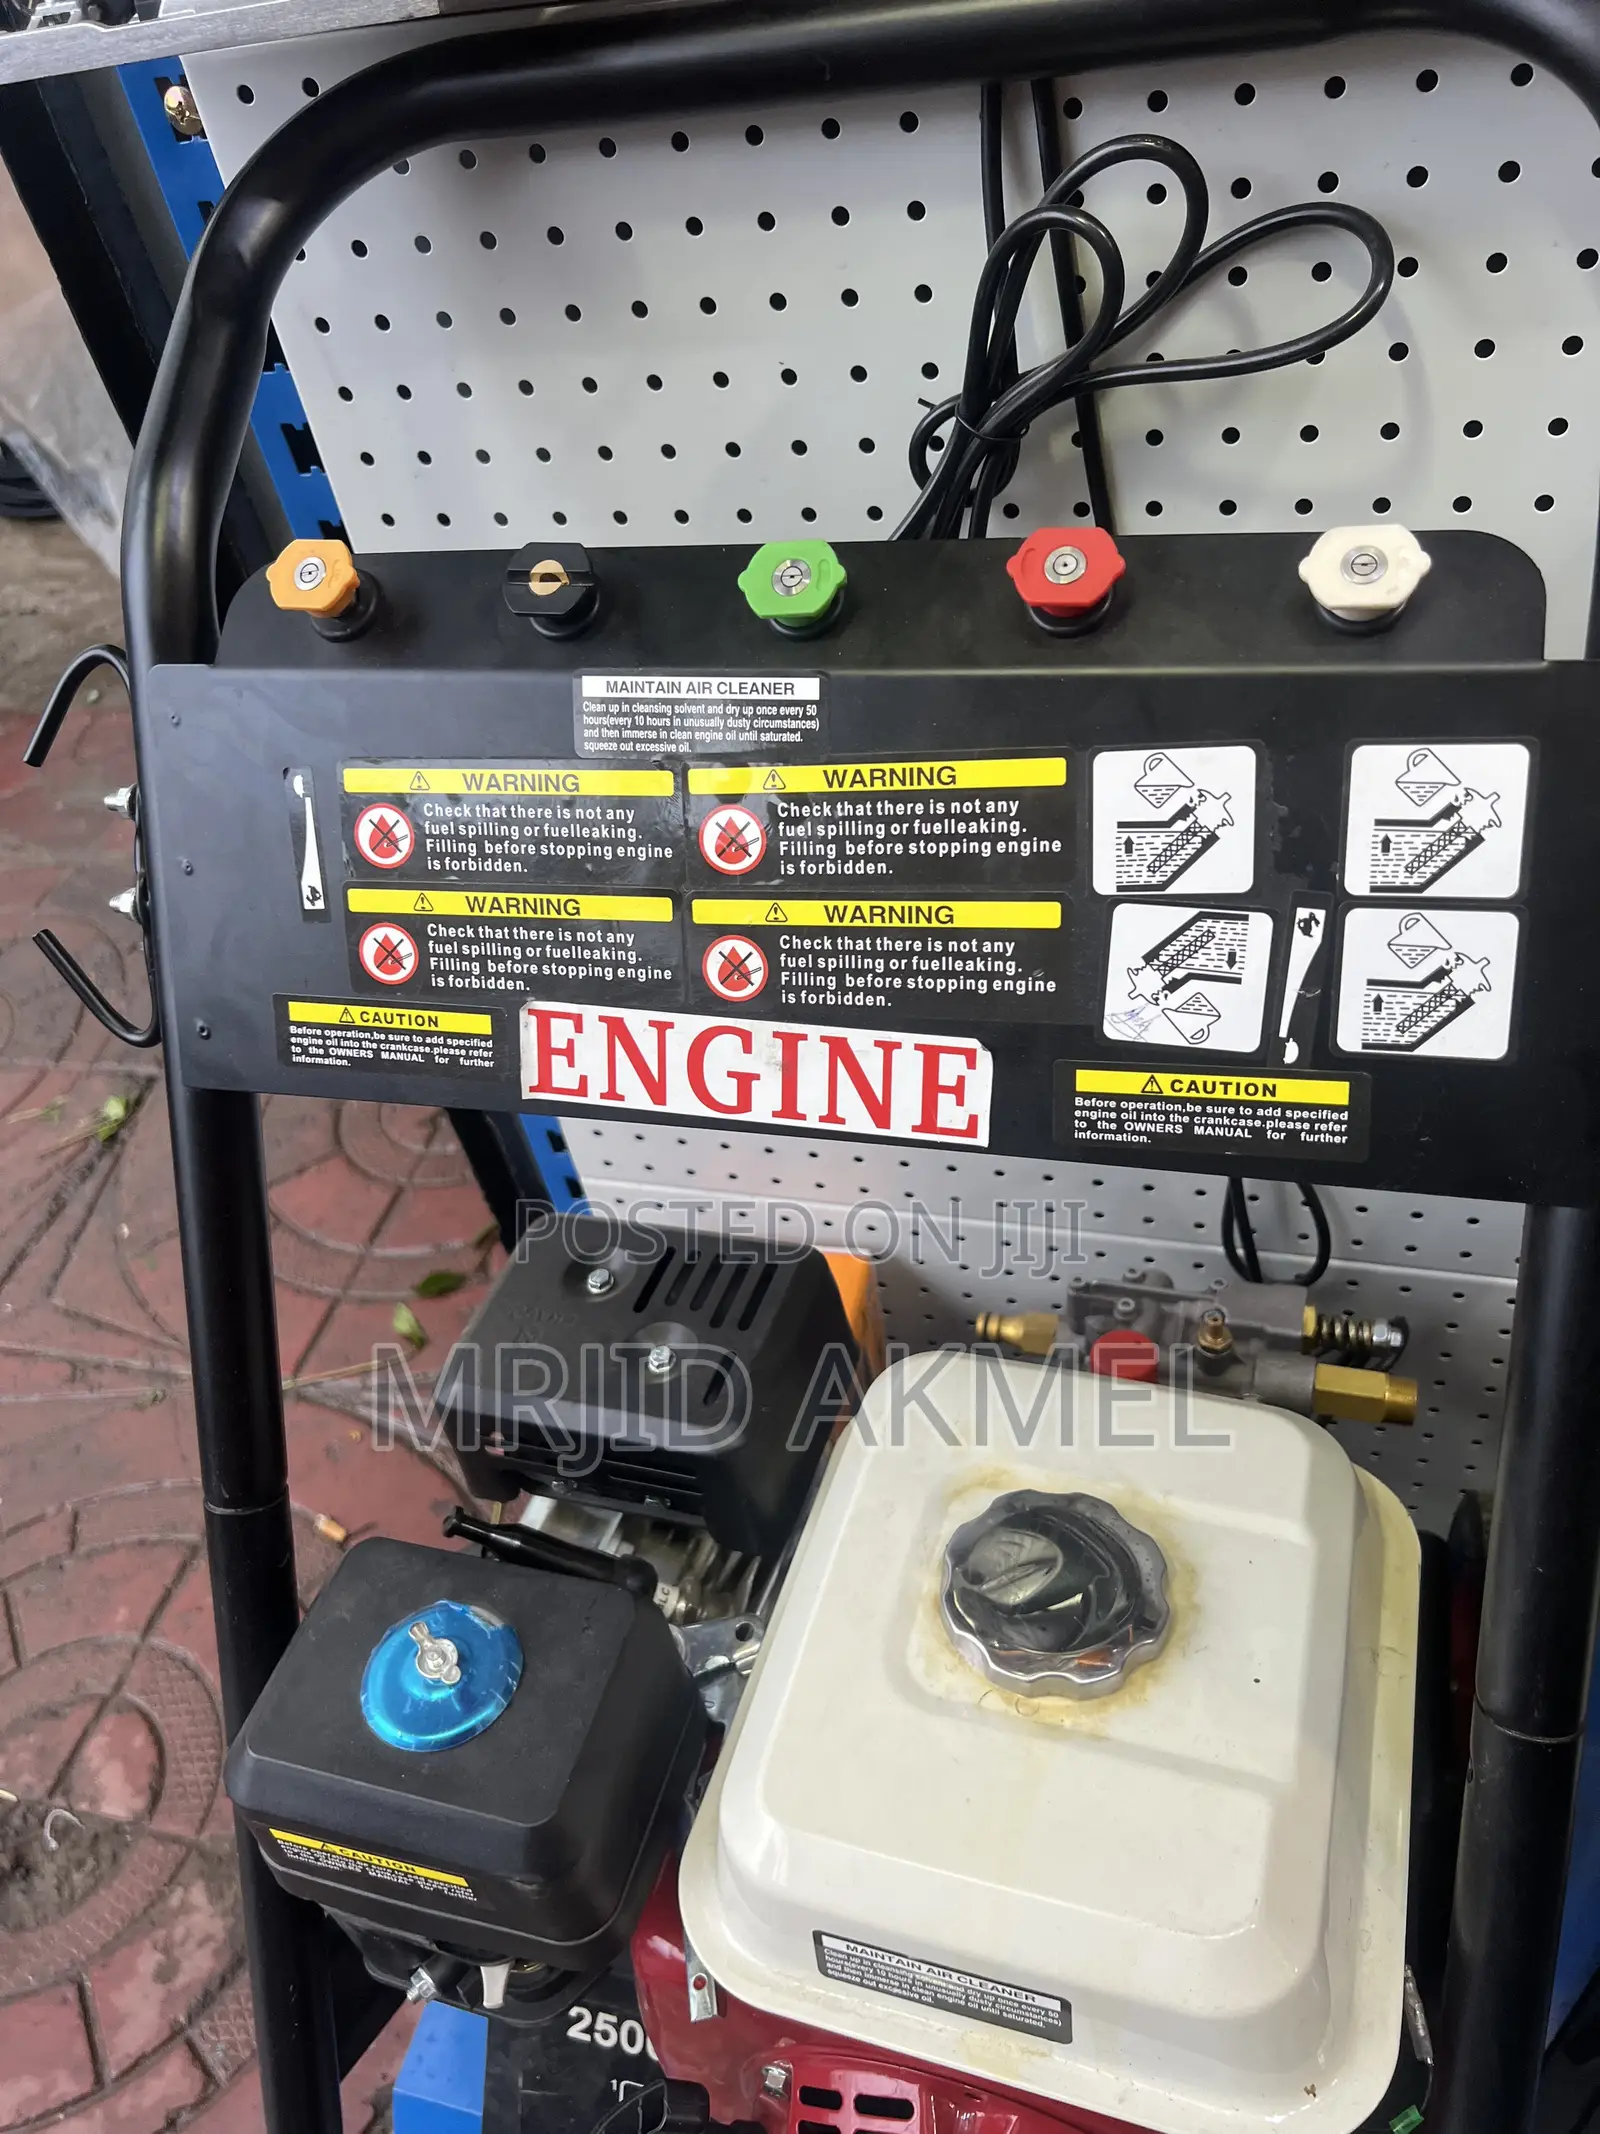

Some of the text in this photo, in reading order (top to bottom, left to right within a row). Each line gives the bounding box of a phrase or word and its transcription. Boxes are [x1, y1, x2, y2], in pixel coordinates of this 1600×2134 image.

[606, 681, 794, 694] MAINTAIN AIR CLEANER
[582, 701, 816, 717] Clean up in cleansing solvent and dry up once every 50
[634, 716, 643, 725] 10
[646, 716, 670, 726] hours
[673, 716, 680, 726] in
[684, 717, 724, 729] unusually
[726, 717, 750, 730] dusty
[753, 717, 818, 730] circumstances)
[584, 728, 802, 742] and then immerse in clean engine oil until saturated.
[584, 741, 691, 752] squeeze out excessive oil.
[462, 773, 579, 792] WARNING
[823, 766, 955, 788] WARNING
[423, 803, 634, 823] Check that there is not any
[778, 799, 1018, 817] Check that there is not any
[425, 823, 454, 835] fuel
[458, 824, 518, 841] spilling
[523, 826, 539, 836] or
[778, 822, 811, 837] fuel
[816, 821, 884, 839] spilling
[890, 823, 908, 834] or
[426, 840, 672, 860] Filling before stopping engine
[780, 838, 1061, 858] Filling before stopping engine
[780, 859, 892, 874] is forbidden.
[465, 896, 580, 916] WARNING
[823, 905, 953, 924] WARNING
[427, 924, 634, 946] Check that there is not any
[428, 943, 458, 954] fuel
[462, 944, 521, 961] spilling
[526, 947, 541, 957] or
[780, 935, 1014, 956] Check that there is not any
[430, 957, 671, 980] Filling before stopping engine
[780, 954, 812, 968] fuel
[817, 956, 883, 974] spilling
[889, 958, 907, 969] or
[431, 975, 529, 990] is forbidden.
[781, 971, 1055, 993] Filling before stopping engine
[782, 990, 891, 1006] is forbidden.
[360, 1011, 438, 1027] CAUTION
[289, 1026, 321, 1035] Before
[388, 1034, 410, 1042] sure
[412, 1034, 422, 1042] to
[425, 1035, 444, 1043] add
[446, 1038, 493, 1048] specified
[291, 1037, 323, 1046] engine
[340, 1039, 359, 1048] into
[469, 1049, 493, 1057] refer
[293, 1055, 351, 1066] information.
[329, 1048, 373, 1058] OWNERS
[381, 1052, 424, 1062] MANUAL
[434, 1056, 449, 1064] for
[460, 1059, 494, 1067] further
[528, 1008, 978, 1138] ENGINE
[1170, 1079, 1276, 1097] CAUTION
[1075, 1097, 1116, 1108] Before
[1206, 1106, 1234, 1115] sure
[1239, 1106, 1252, 1115] to
[1256, 1107, 1281, 1116] add
[1285, 1109, 1348, 1121] specified
[1074, 1110, 1116, 1120] engine
[1121, 1112, 1137, 1121] oil
[1140, 1112, 1166, 1122] into
[1169, 1114, 1189, 1123] the
[1314, 1121, 1346, 1131] refer
[1074, 1130, 1151, 1143] information.
[1075, 1120, 1347, 1143] to the OWNERS MANUAL for further
[339, 1849, 416, 1873] CAUTION
[846, 1944, 1036, 2003] MAINTAIN AIR CLEANER
